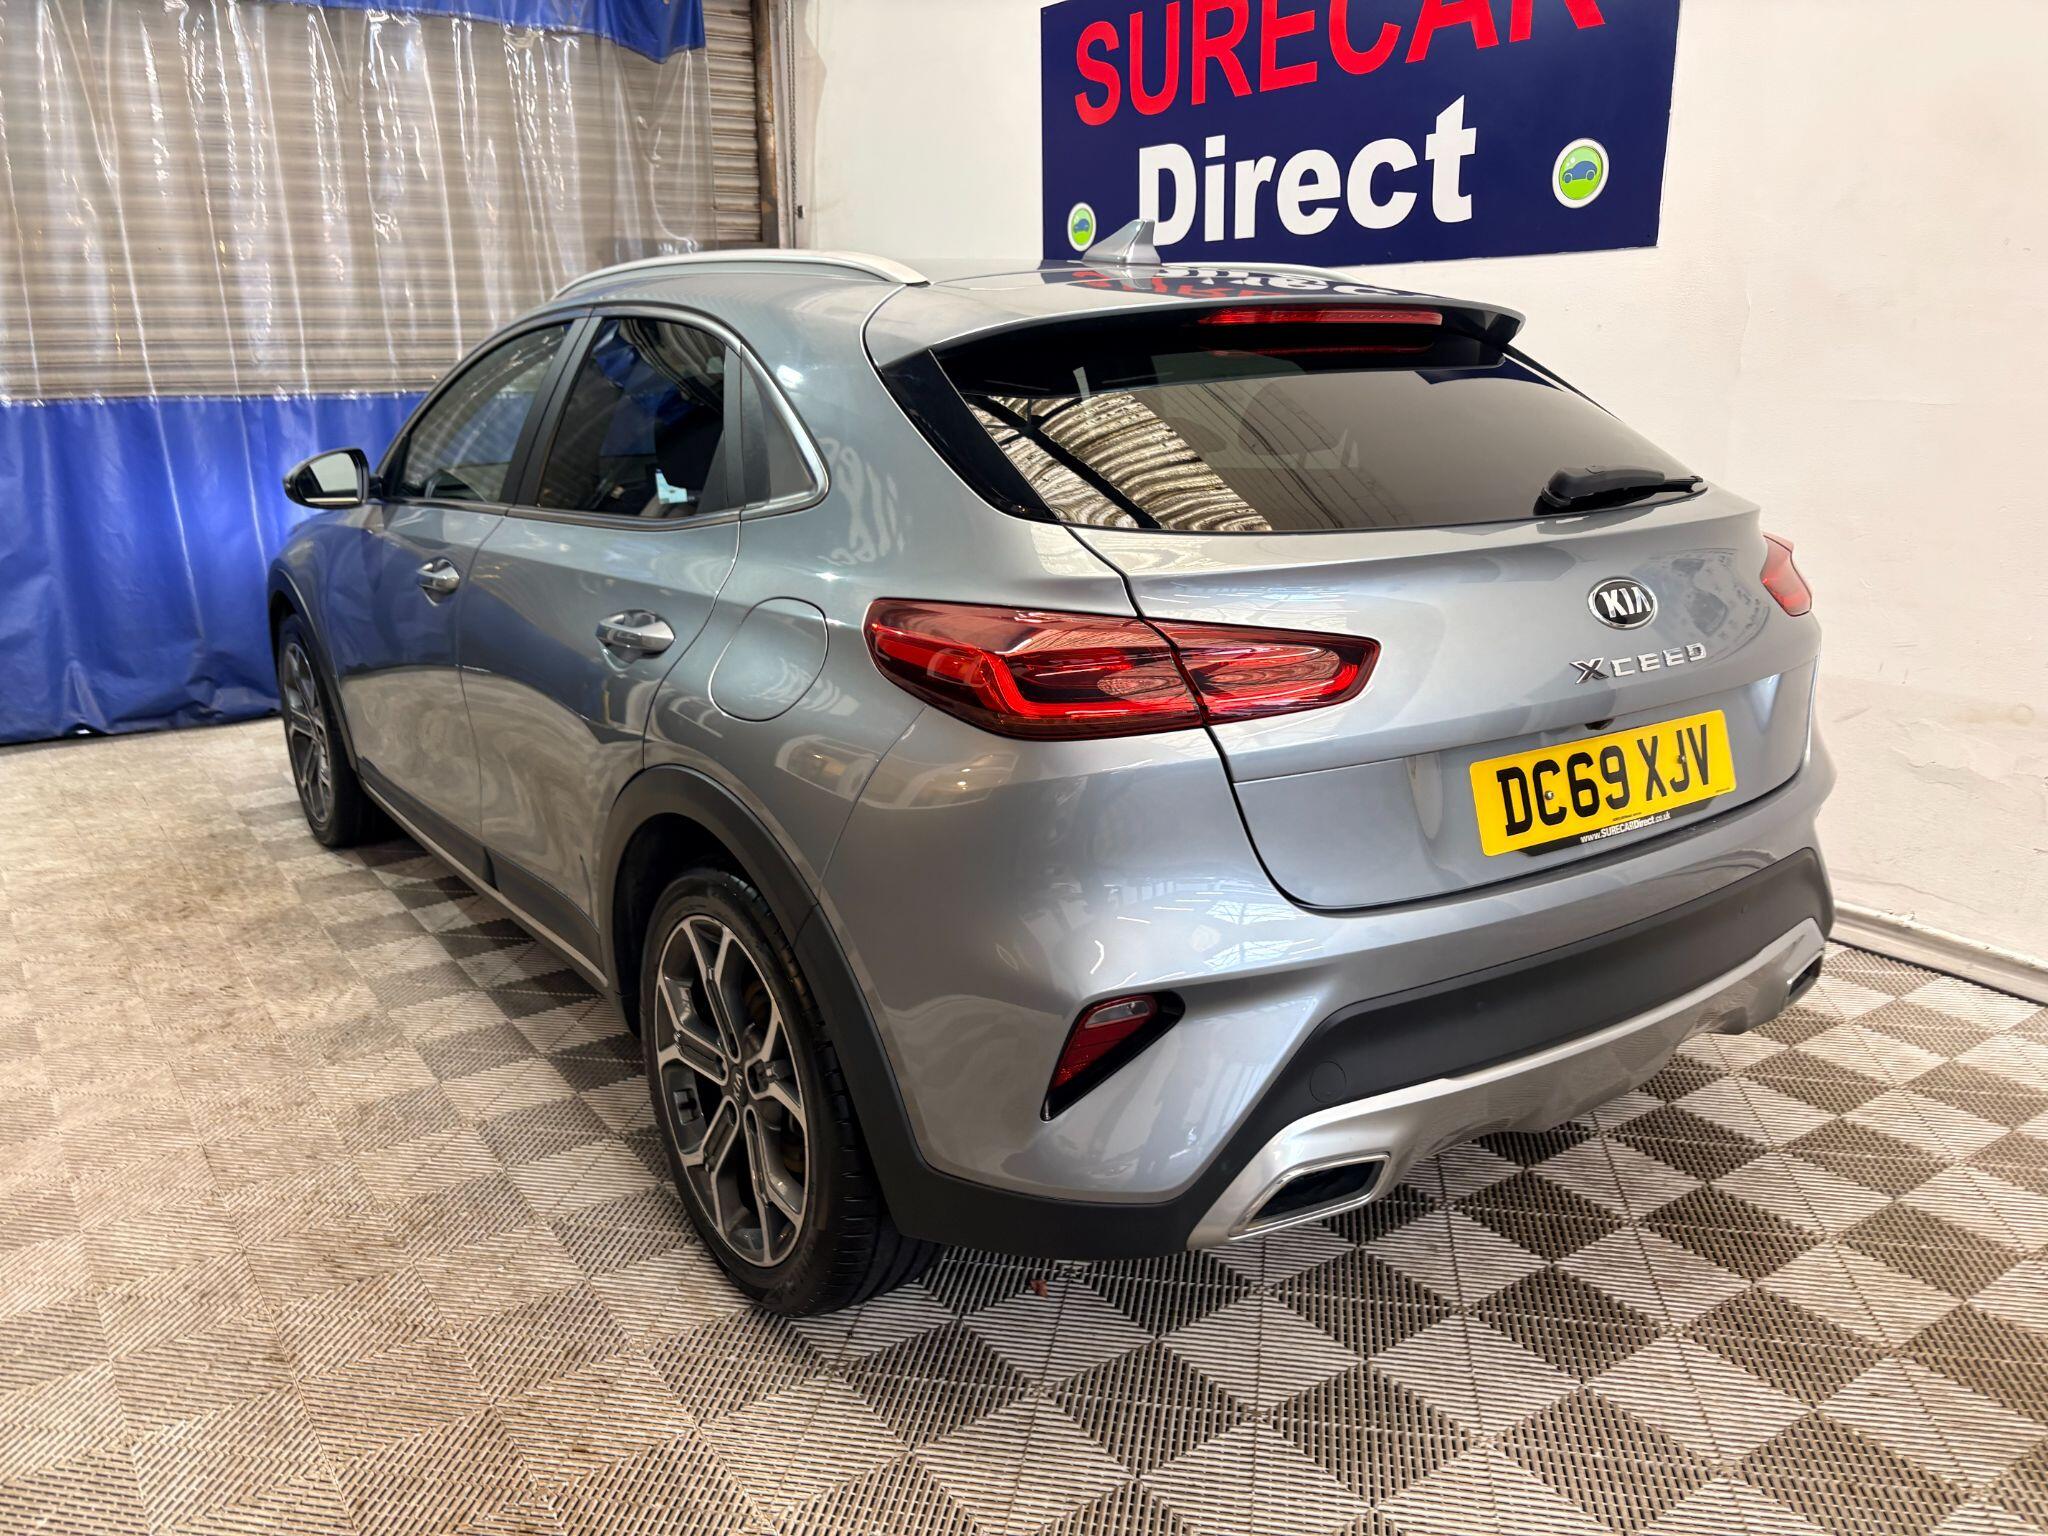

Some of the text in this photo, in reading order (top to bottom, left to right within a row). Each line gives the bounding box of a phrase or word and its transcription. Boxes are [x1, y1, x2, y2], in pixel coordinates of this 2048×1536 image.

[1138, 94, 1477, 246] Direct
[1600, 586, 1654, 618] KIA
[1569, 642, 1707, 684] XCEED
[1496, 723, 1709, 837] DC69 XJV
[1580, 811, 1671, 843] www.SURECARDirect.co.uk
